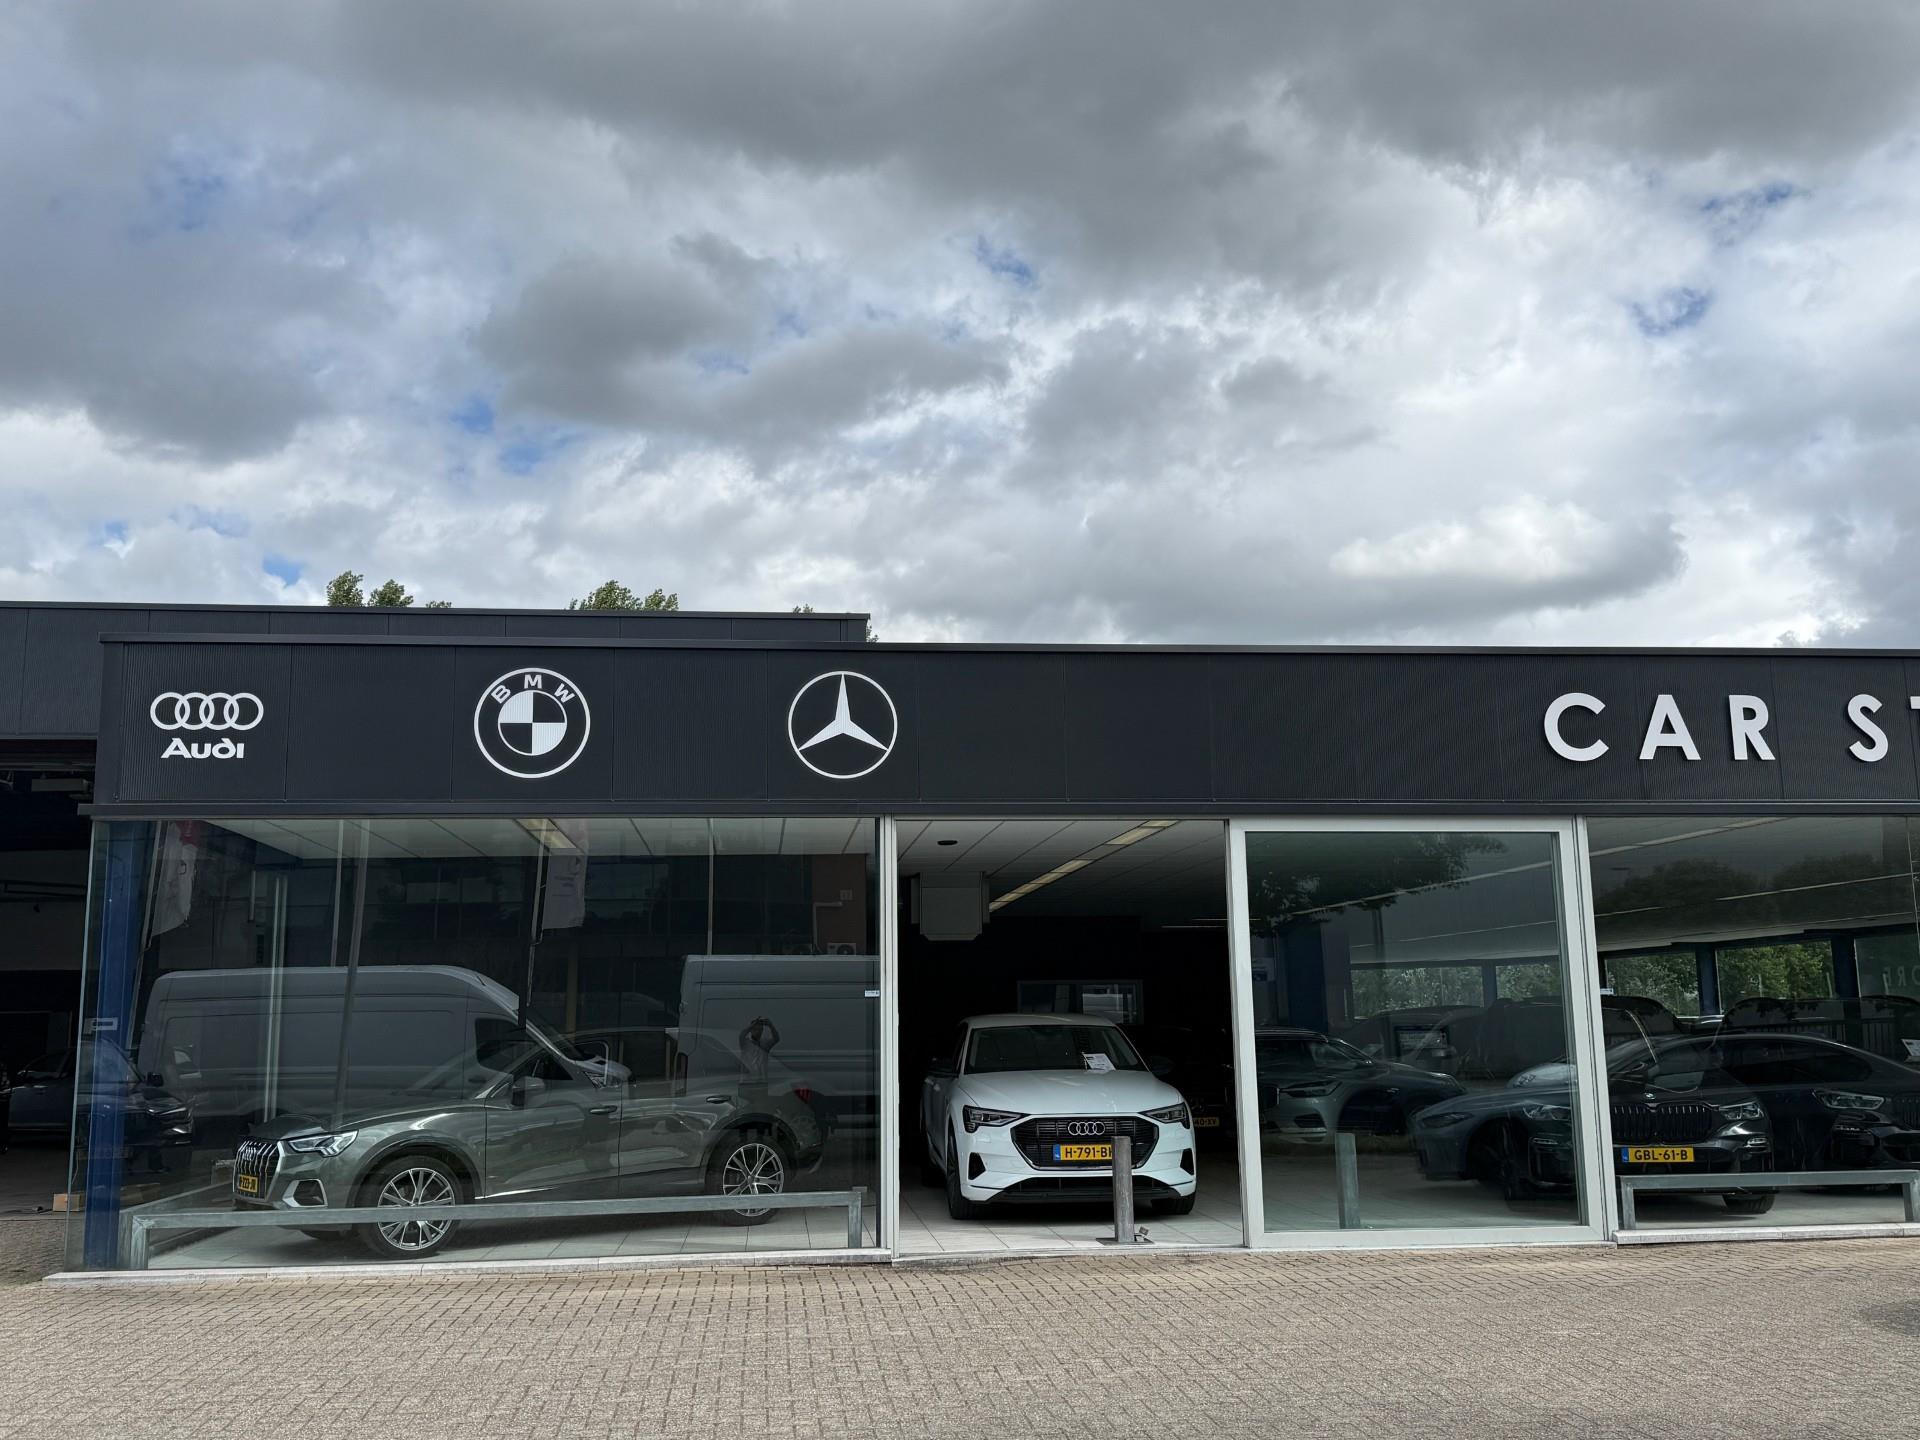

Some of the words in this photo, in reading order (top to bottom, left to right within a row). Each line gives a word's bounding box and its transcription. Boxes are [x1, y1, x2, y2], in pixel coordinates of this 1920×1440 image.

[491, 674, 576, 704] BMW
[1544, 692, 1776, 762] CAR
[160, 737, 245, 759] Audi
[1634, 1149, 1688, 1161] GBL-61-B
